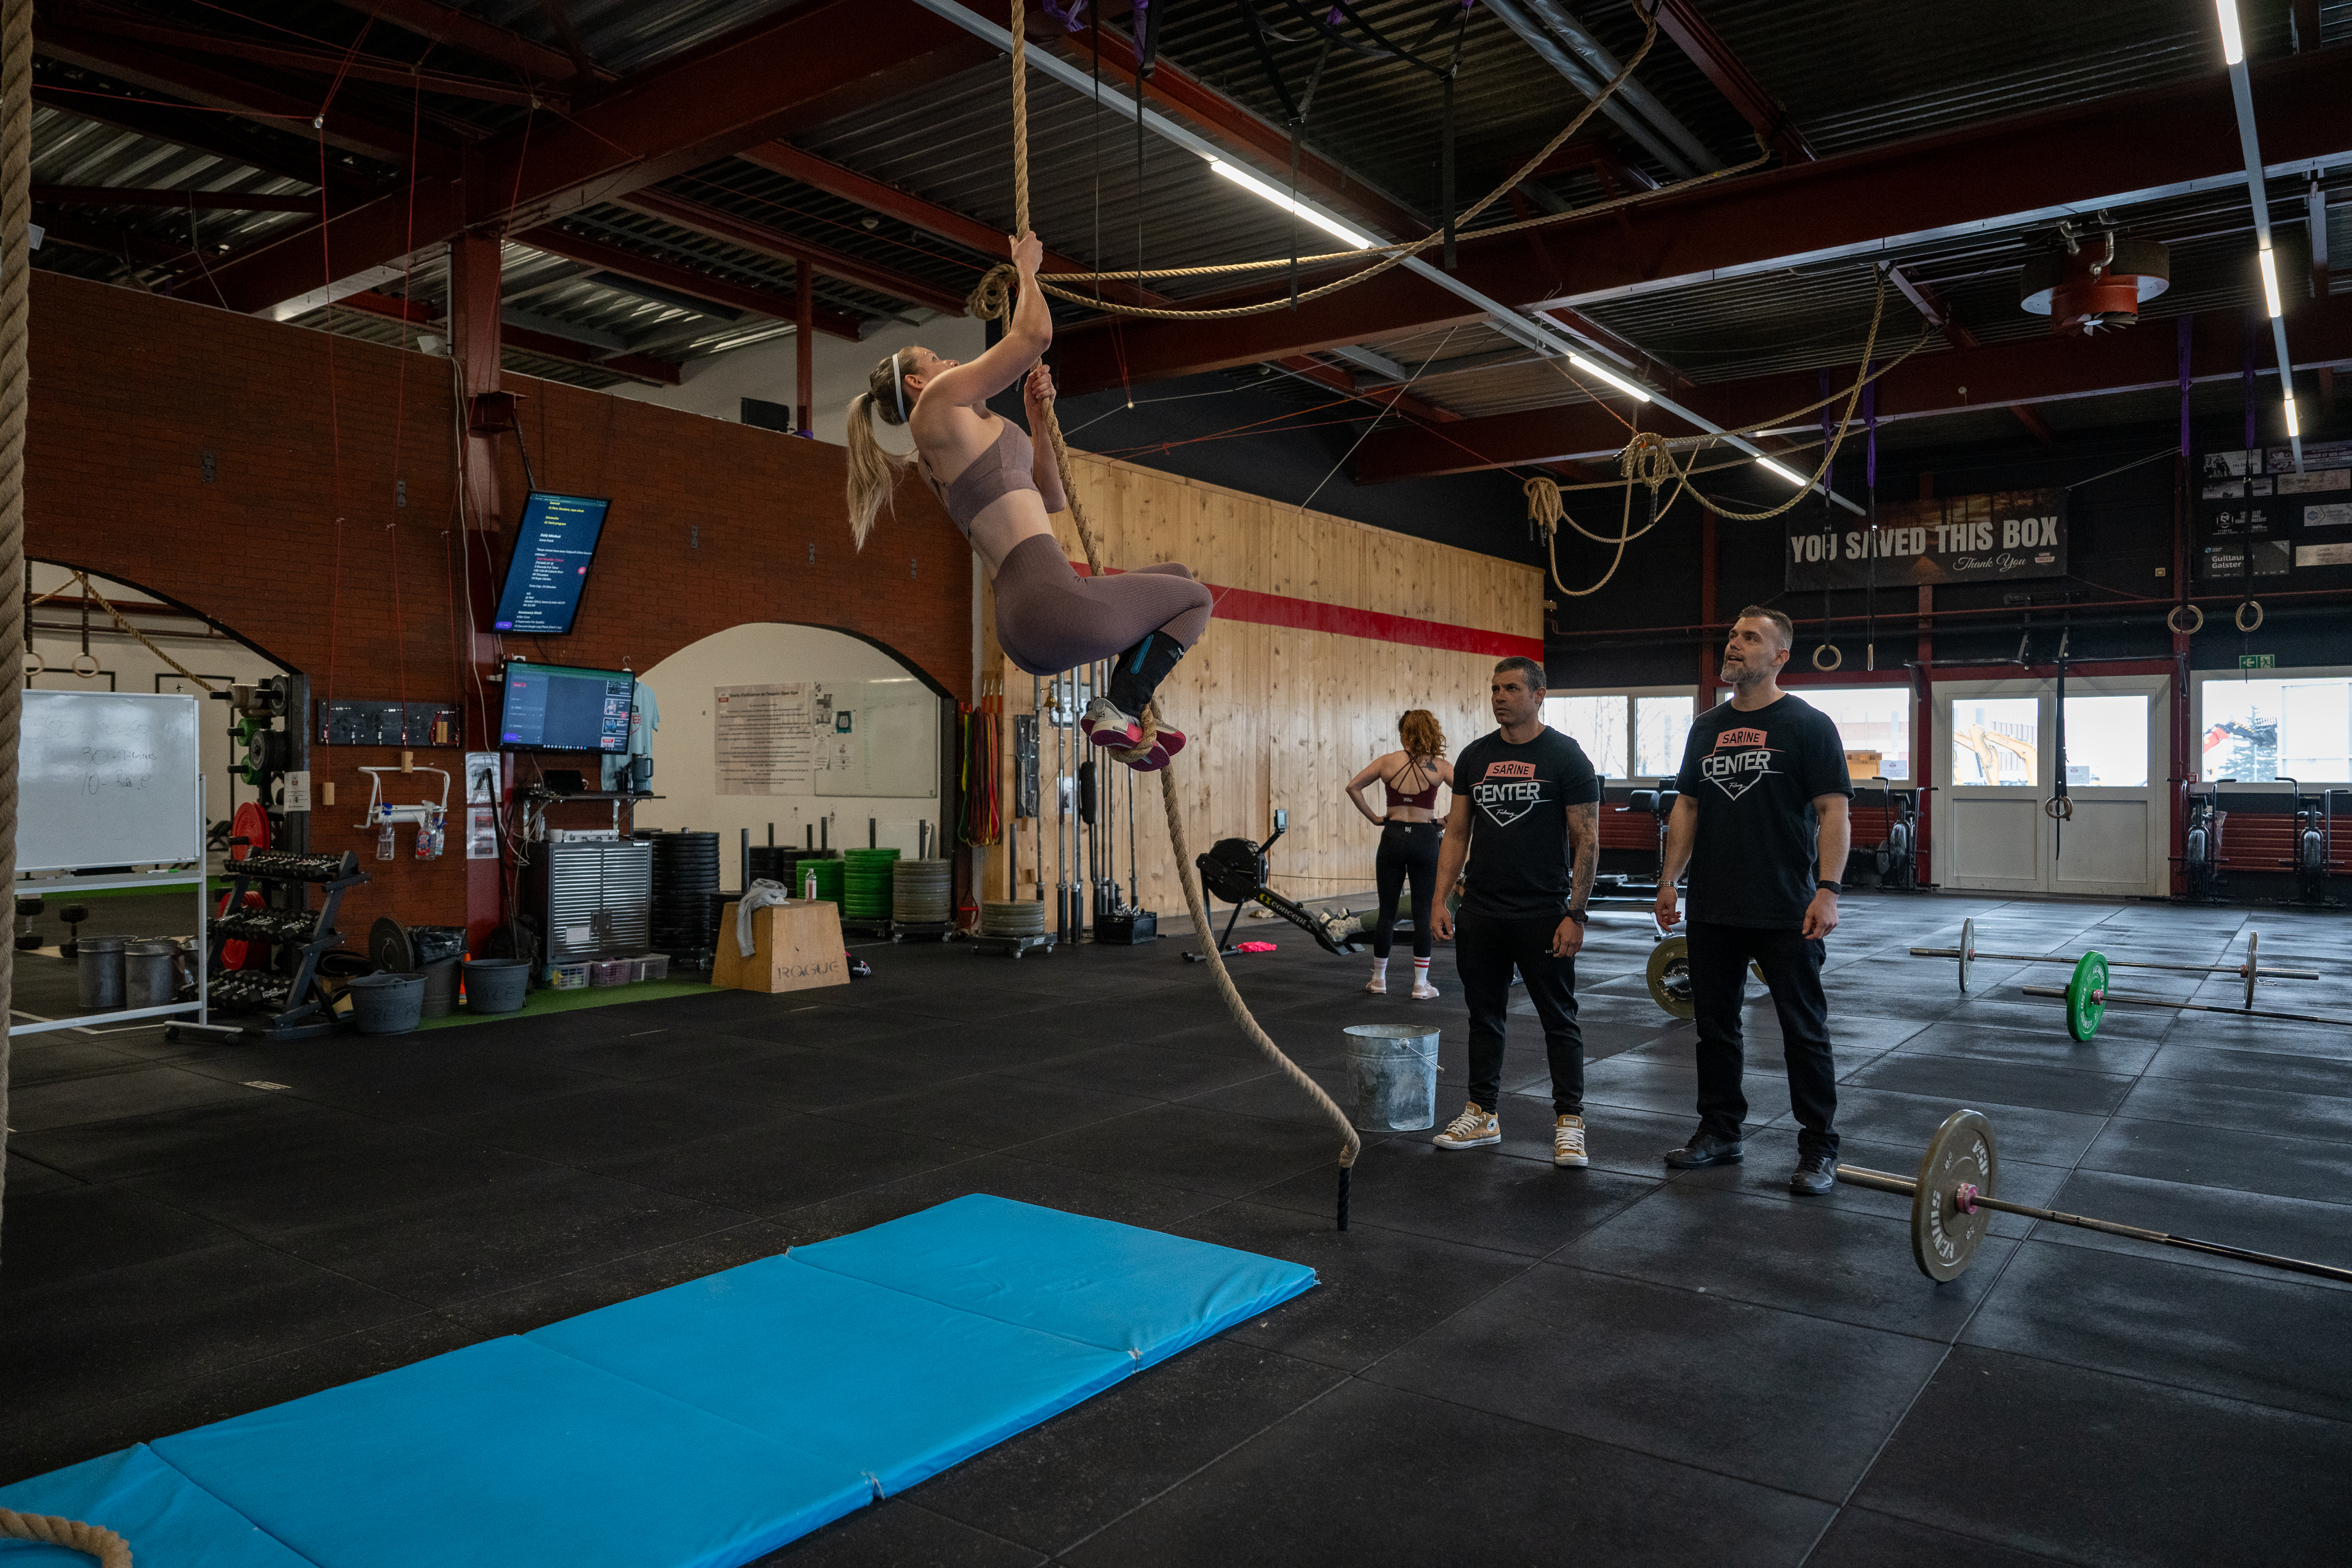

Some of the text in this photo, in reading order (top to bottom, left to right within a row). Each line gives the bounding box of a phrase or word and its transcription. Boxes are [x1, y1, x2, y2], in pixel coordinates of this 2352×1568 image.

[1790, 516, 2057, 563] YOU SAVED THIS BOX
[1953, 553, 2026, 573] Thank You
[1722, 731, 1760, 744] SARINE
[78, 747, 109, 767] 30
[1702, 751, 1771, 778] CENTER
[1492, 764, 1530, 775] SARINE
[81, 771, 99, 795] 10
[1472, 782, 1541, 803] CENTER
[1496, 809, 1519, 818] Fribourg
[1271, 901, 1308, 925] concept
[777, 961, 839, 979] ROGUE
[1972, 1139, 1989, 1176] USA
[1930, 1190, 1954, 1259] XENIOS
